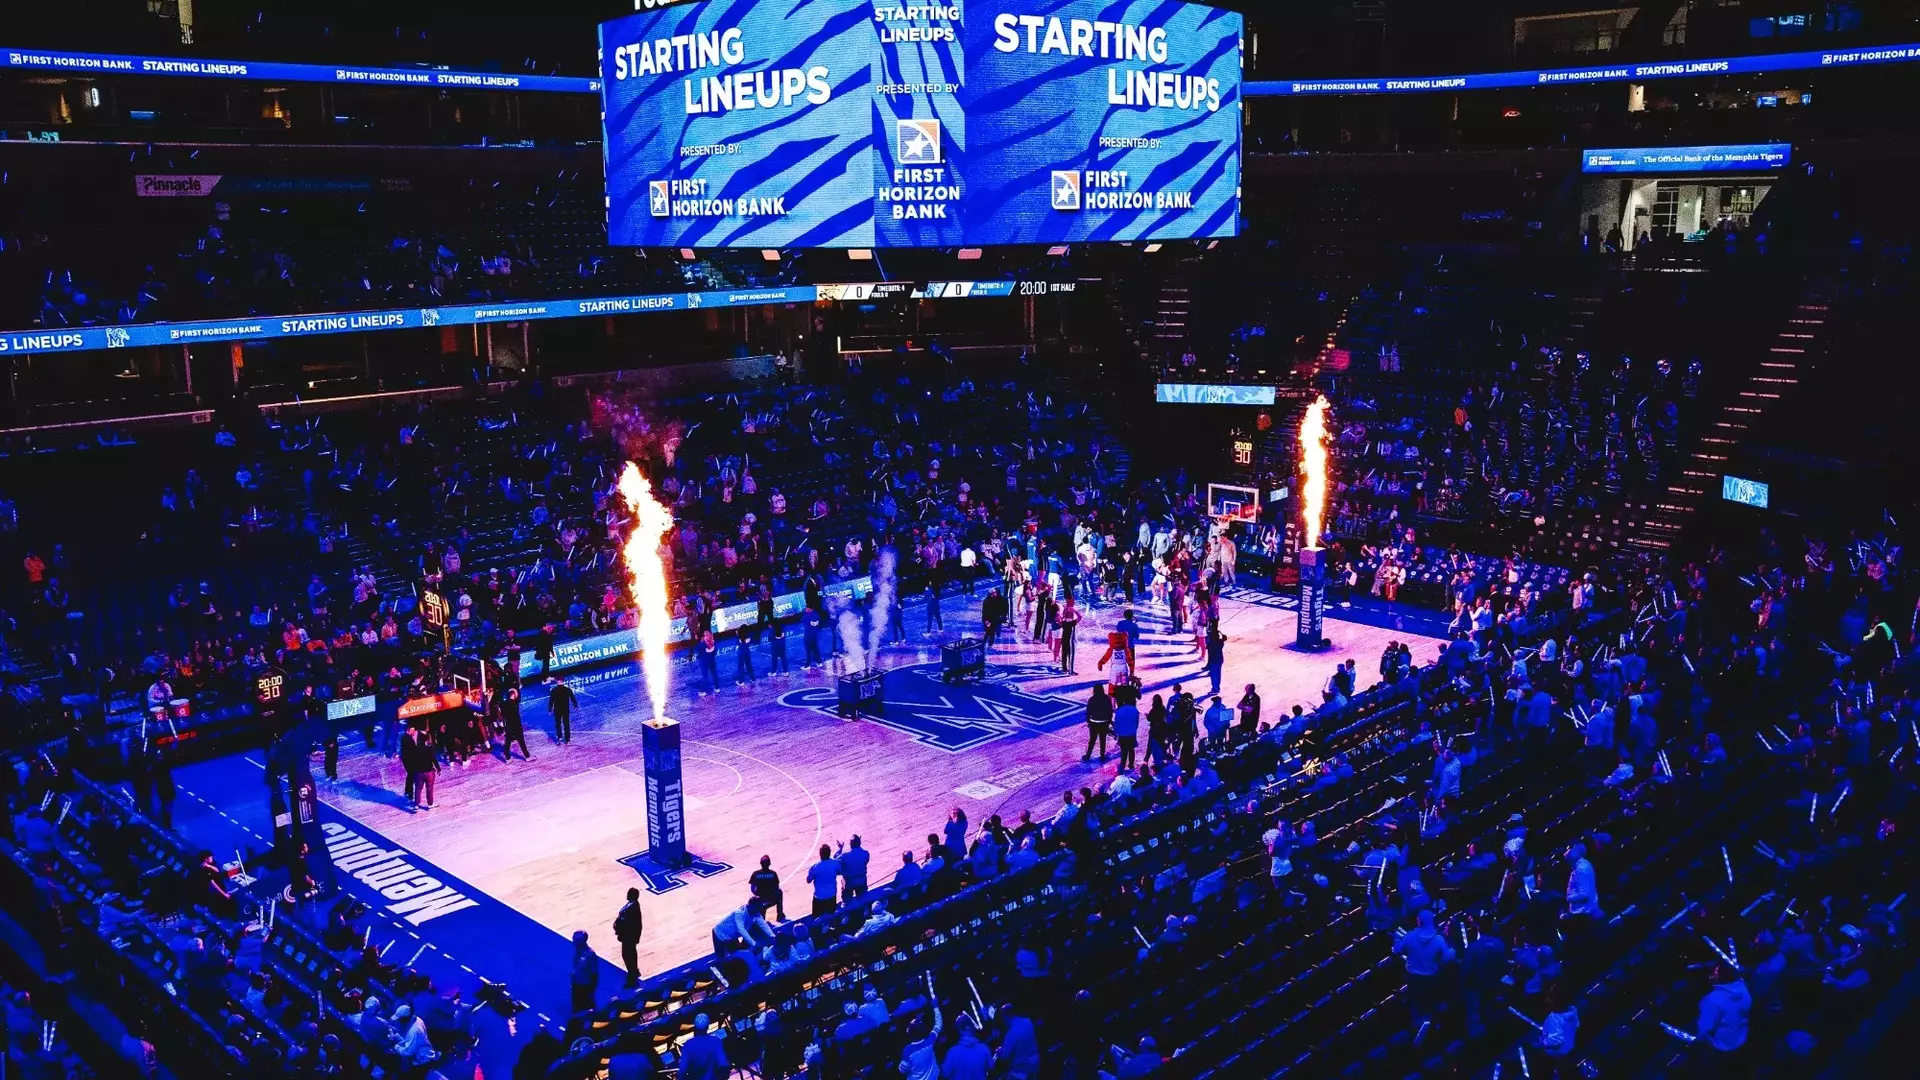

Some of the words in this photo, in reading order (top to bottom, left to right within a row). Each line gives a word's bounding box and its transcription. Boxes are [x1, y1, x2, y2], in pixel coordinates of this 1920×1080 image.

[874, 6, 960, 22] STARTING
[880, 27, 955, 42] LINEUPS
[993, 13, 1168, 64] STARTING
[22, 55, 51, 65] FIRST
[54, 57, 101, 67] HORIZON
[614, 27, 745, 81] STARTING
[1832, 53, 1860, 63] FIRST
[1861, 50, 1906, 61] HORIZON
[142, 60, 199, 73] STARTING
[201, 63, 248, 75] LINEUPS
[1635, 65, 1685, 76] STARTING
[1685, 61, 1729, 73] LINEUPS
[345, 71, 369, 80] FIRST
[369, 72, 406, 82] HORIZON
[437, 74, 482, 85] STARTING
[483, 76, 519, 87] LINEUPS
[1547, 73, 1568, 81] FIRST
[1568, 71, 1604, 80] HORIZON
[684, 65, 832, 114] LINEUPS
[876, 83, 942, 94] PRESENTED
[945, 83, 960, 93] BY
[1107, 67, 1220, 112] LINEUPS
[1386, 80, 1430, 90] STARTING
[1431, 78, 1466, 88] LINEUPS
[680, 144, 726, 157] PRESENTED
[728, 143, 742, 155] BY:
[1099, 136, 1148, 148] PRESENTED
[1150, 138, 1162, 149] BY:
[1657, 155, 1683, 163] Official
[1725, 153, 1759, 162] Memphis
[1760, 153, 1783, 162] Tigers
[894, 168, 944, 183] FIRST
[1085, 170, 1128, 188] FIRST
[671, 178, 707, 196] FIRST
[879, 186, 960, 201] HORIZON
[672, 198, 733, 217] HORIZON
[1085, 192, 1152, 209] HORIZON
[892, 203, 947, 219] BANK
[1020, 281, 1046, 295] 20:00
[1060, 282, 1075, 291] HALF
[579, 300, 630, 312] STARTING
[632, 297, 673, 309] LINEUPS
[281, 317, 347, 333] STARTING
[350, 314, 404, 328] LINEUPS
[179, 329, 201, 337] FIRST
[202, 327, 239, 336] HORIZON
[13, 334, 83, 350] LINEUPS
[1234, 441, 1252, 451] 20:00
[1235, 449, 1251, 464] 30
[427, 602, 443, 625] 30
[1300, 585, 1313, 634] Memphis
[558, 644, 583, 656] FIRST
[560, 649, 602, 665] HORIZON
[258, 675, 283, 689] 20:00
[263, 686, 280, 700] 30
[647, 776, 661, 848] Memphis
[662, 779, 682, 843] Tigers
[321, 822, 481, 927] Memphis
